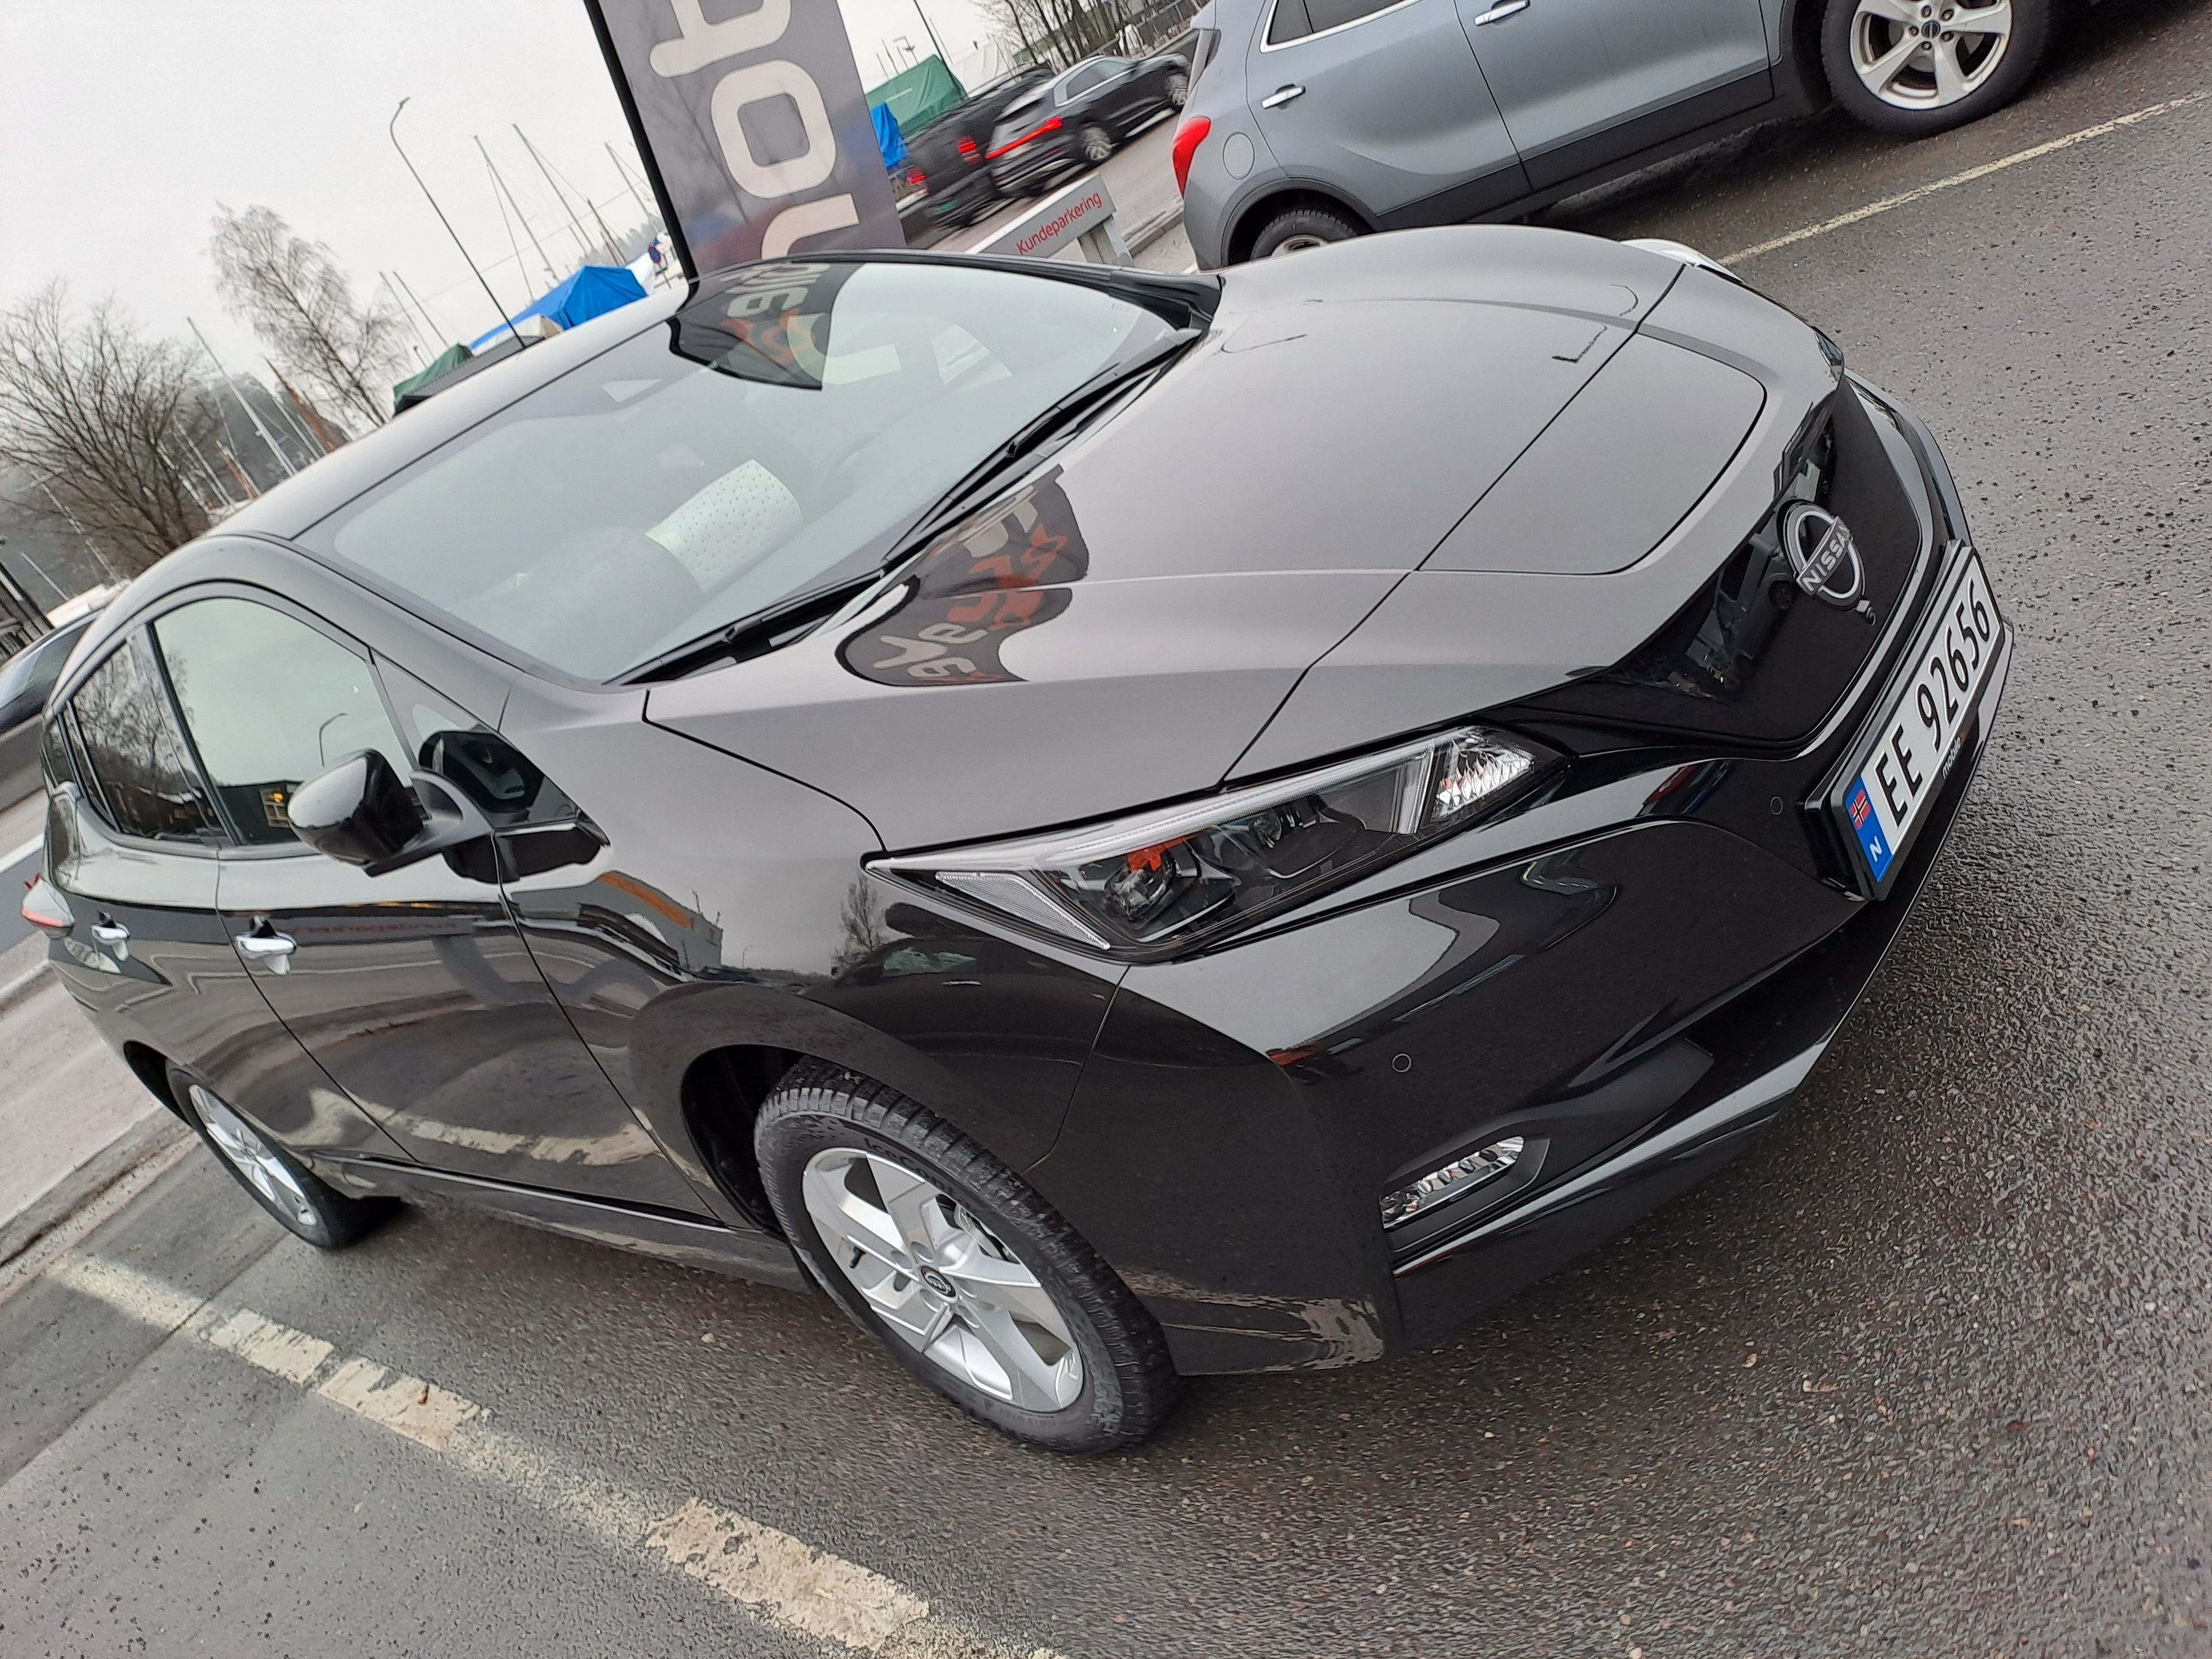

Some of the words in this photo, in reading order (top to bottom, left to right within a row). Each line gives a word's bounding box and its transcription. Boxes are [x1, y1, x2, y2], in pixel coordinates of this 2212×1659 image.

[1016, 192, 1102, 255] Kundeparkering
[1802, 525, 1850, 592] NISSAN
[1873, 722, 1923, 829] EE
[1915, 577, 1990, 754] 92656
[1942, 735, 1961, 780] mobile
[1869, 835, 1882, 863] N
